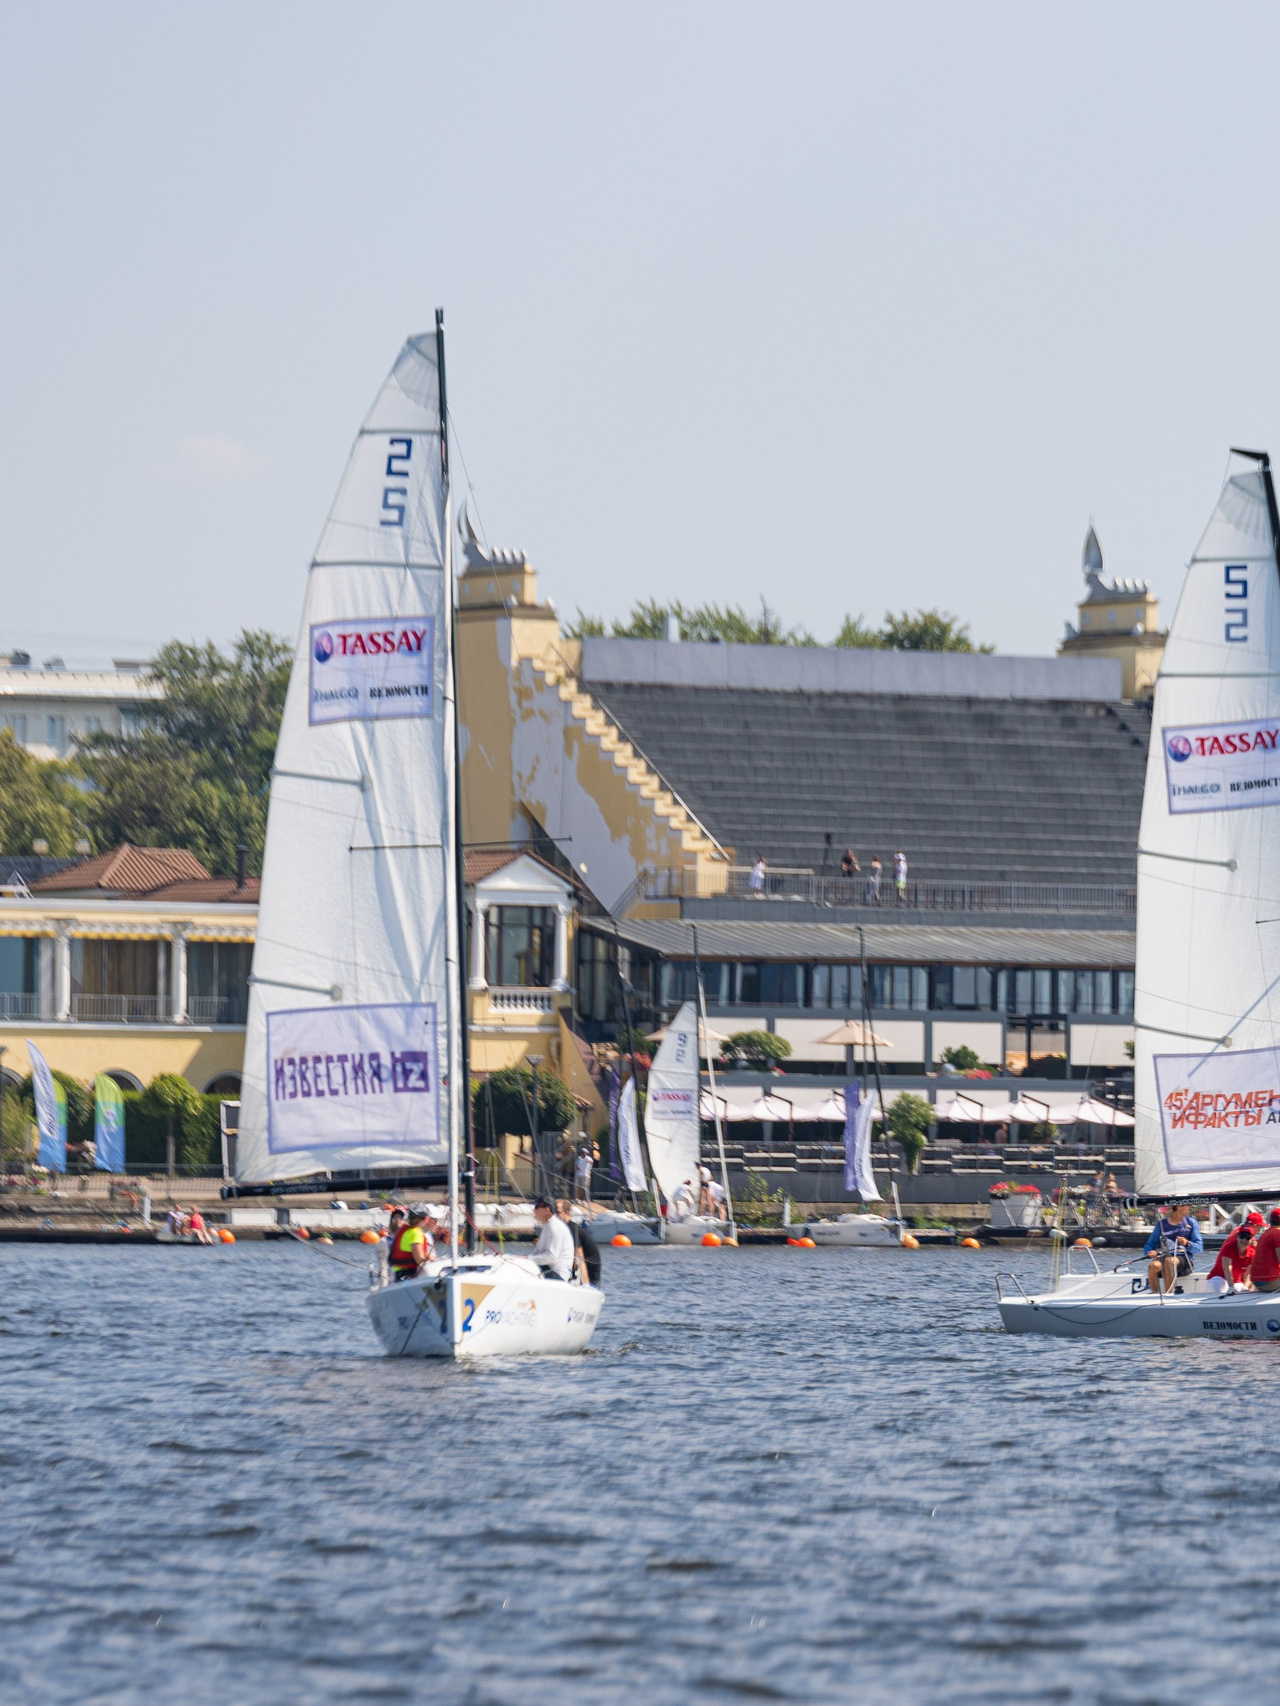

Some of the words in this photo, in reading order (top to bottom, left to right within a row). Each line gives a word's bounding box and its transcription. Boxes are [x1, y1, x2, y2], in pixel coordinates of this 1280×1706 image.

[386, 438, 413, 477] 2
[1224, 565, 1248, 599] 5
[336, 629, 428, 656] TASSAY
[1195, 729, 1280, 757] TASSAY
[1172, 783, 1221, 797] THALGO
[274, 1052, 384, 1101] ИЗВЕСТИЯ
[461, 1298, 475, 1332] 2
